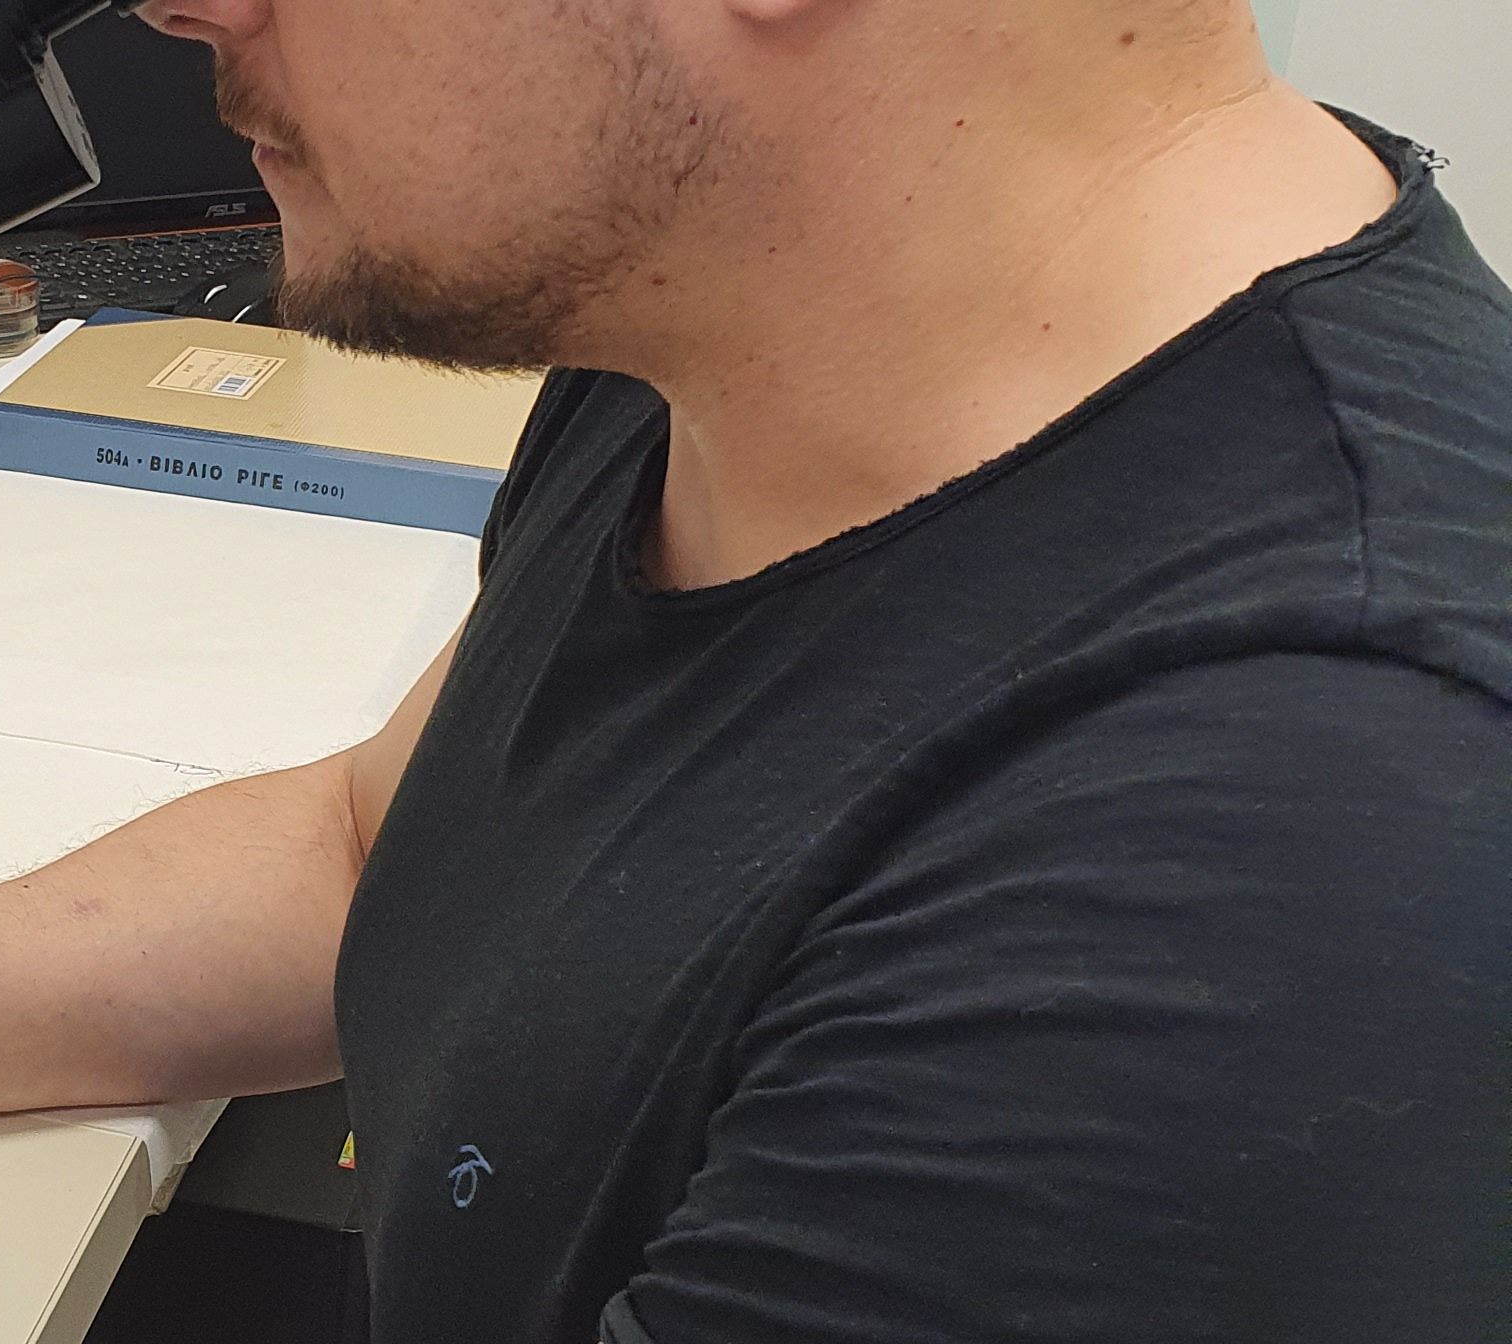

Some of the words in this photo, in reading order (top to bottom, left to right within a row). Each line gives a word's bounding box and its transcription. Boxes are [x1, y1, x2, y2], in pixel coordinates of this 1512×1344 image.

[204, 202, 246, 218] ASUS
[149, 455, 223, 481] ΒΙΒΛΙΟ
[237, 469, 284, 490] ΡΙΓΕ
[294, 479, 345, 500] (Φ200)
